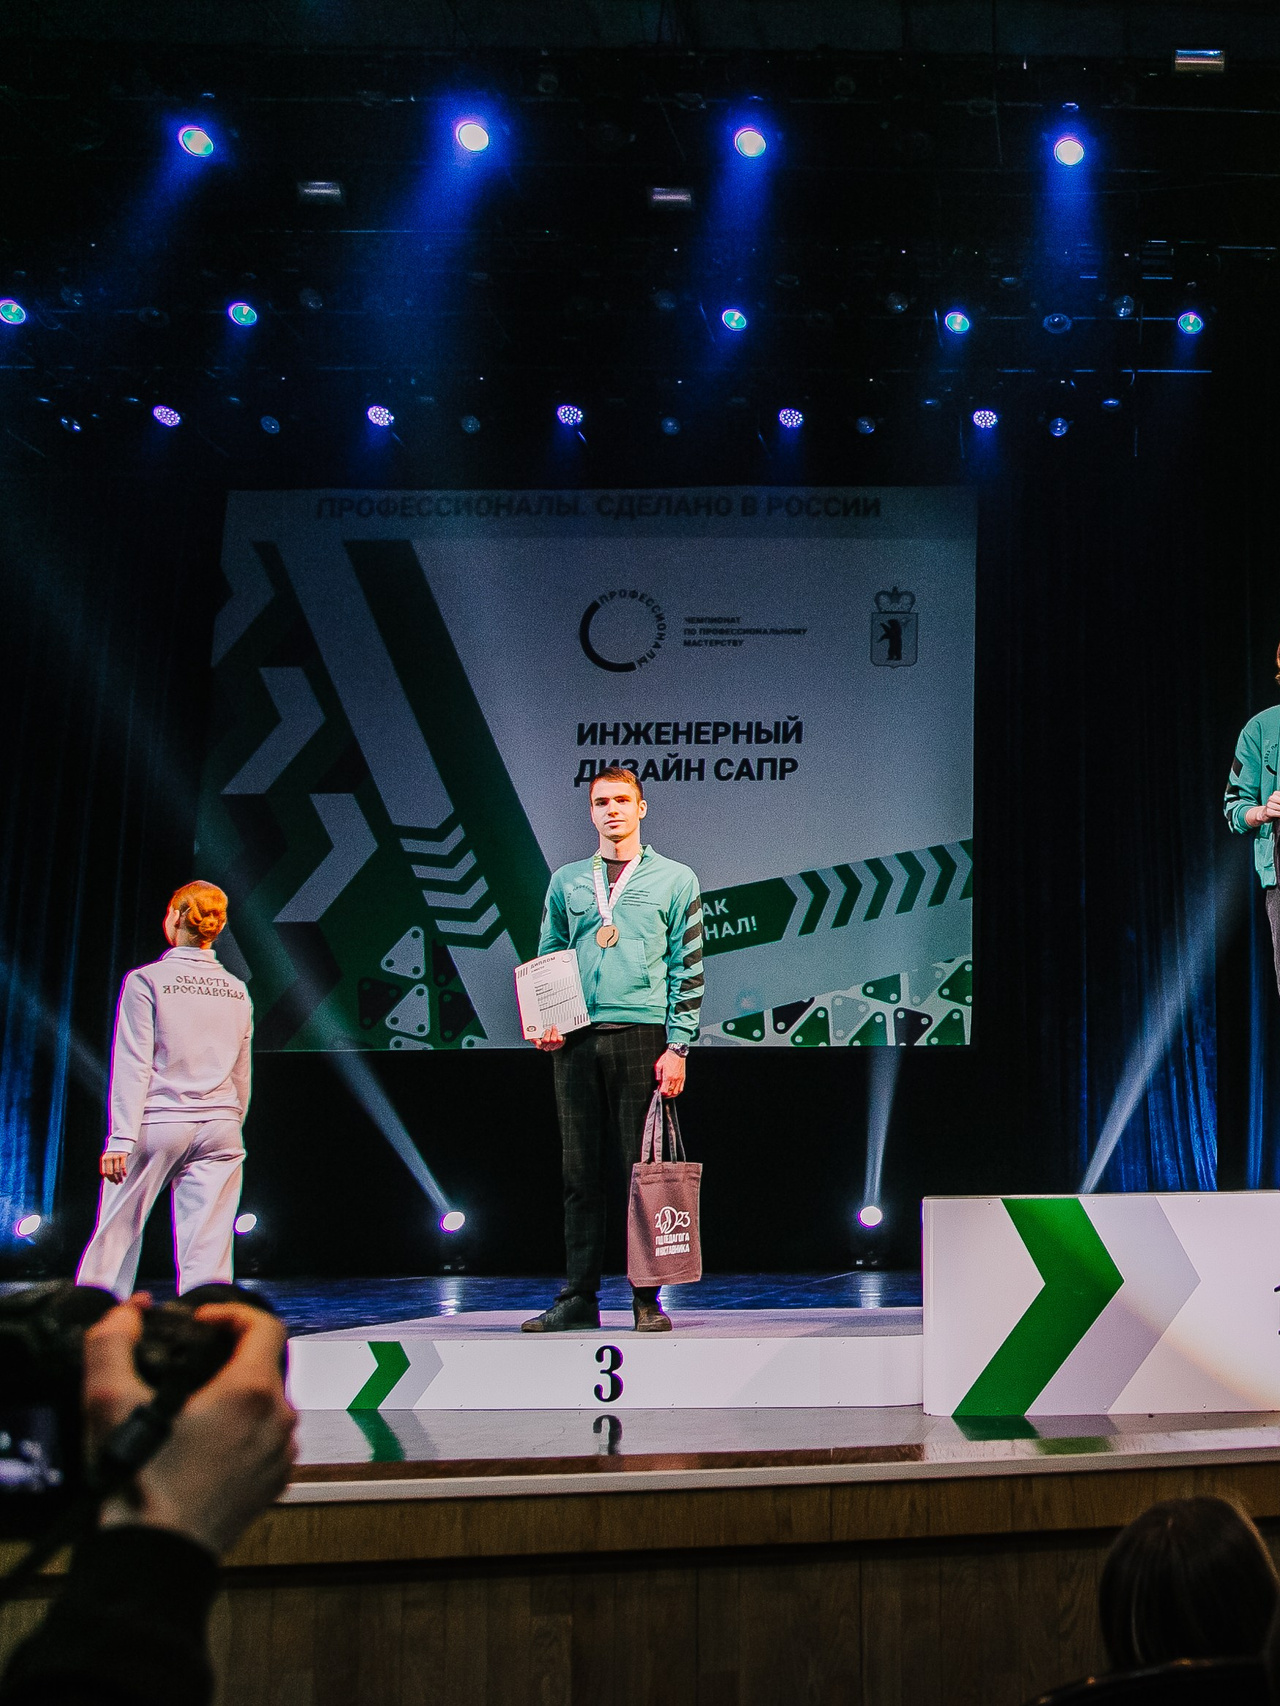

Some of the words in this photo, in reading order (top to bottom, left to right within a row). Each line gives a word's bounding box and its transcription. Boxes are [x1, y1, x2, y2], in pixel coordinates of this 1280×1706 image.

[595, 494, 732, 520] СДЕЛАНО
[740, 496, 758, 517] В
[766, 495, 881, 518] РОССИИ
[600, 588, 667, 668] ПРОФЕССИОНАЛЫ
[683, 639, 744, 647] МАСТЕРСТВУ
[576, 714, 803, 746] ИНЖЕНЕРНЫЙ
[713, 757, 798, 781] САПР
[163, 985, 245, 1000] ЯРОСЛАВСКАЯ
[175, 975, 229, 987] ОБЛАСТЬ
[594, 1345, 624, 1402] 3
